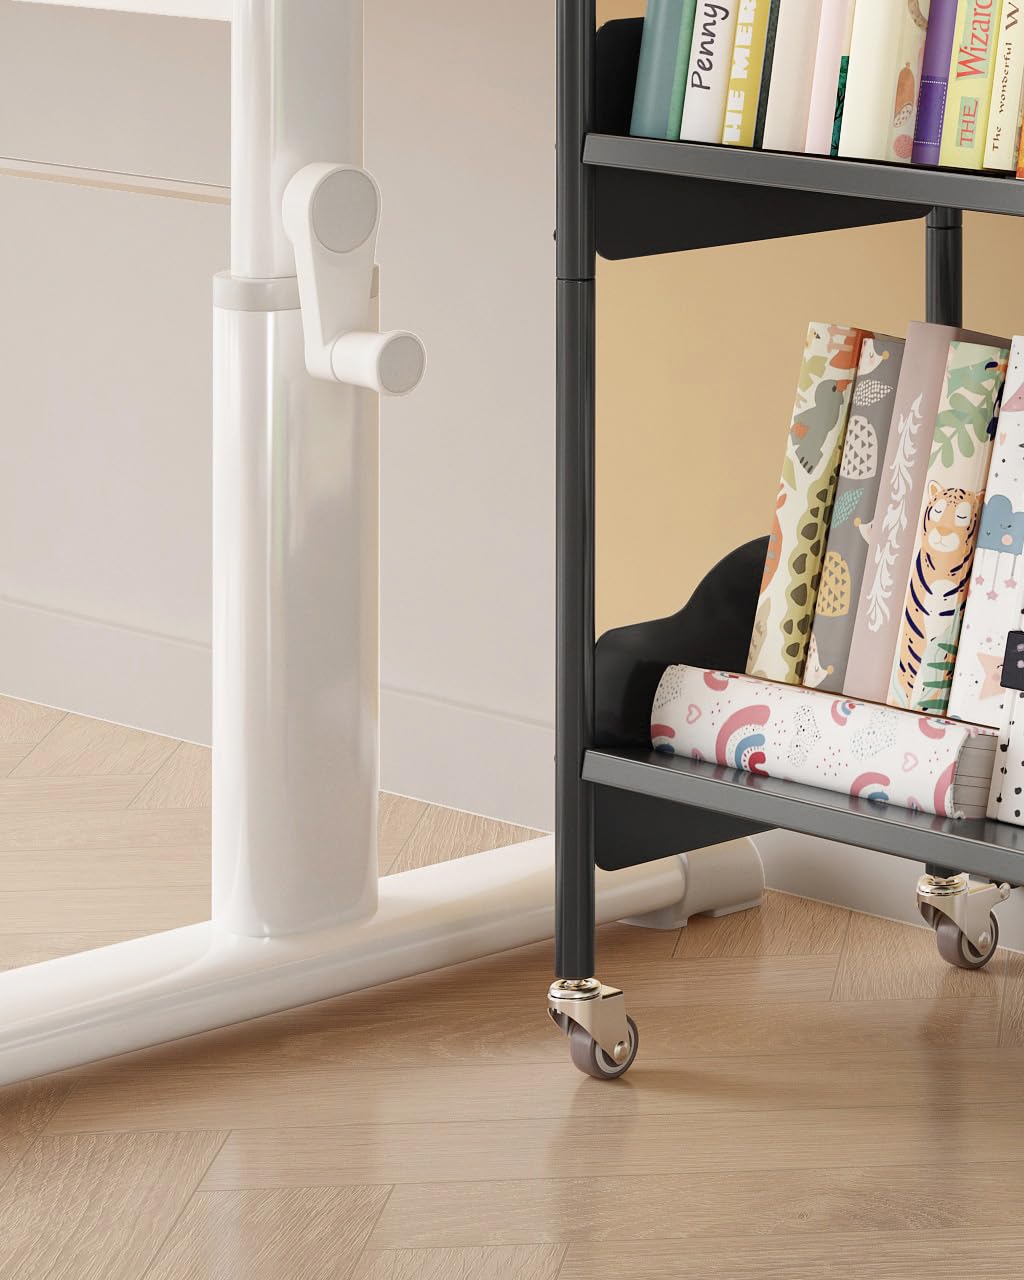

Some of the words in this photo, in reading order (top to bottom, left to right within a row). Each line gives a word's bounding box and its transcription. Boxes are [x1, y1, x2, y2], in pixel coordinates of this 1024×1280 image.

[691, 3, 730, 90] Penny
[960, 98, 979, 146] THE
[992, 126, 1002, 151] The
